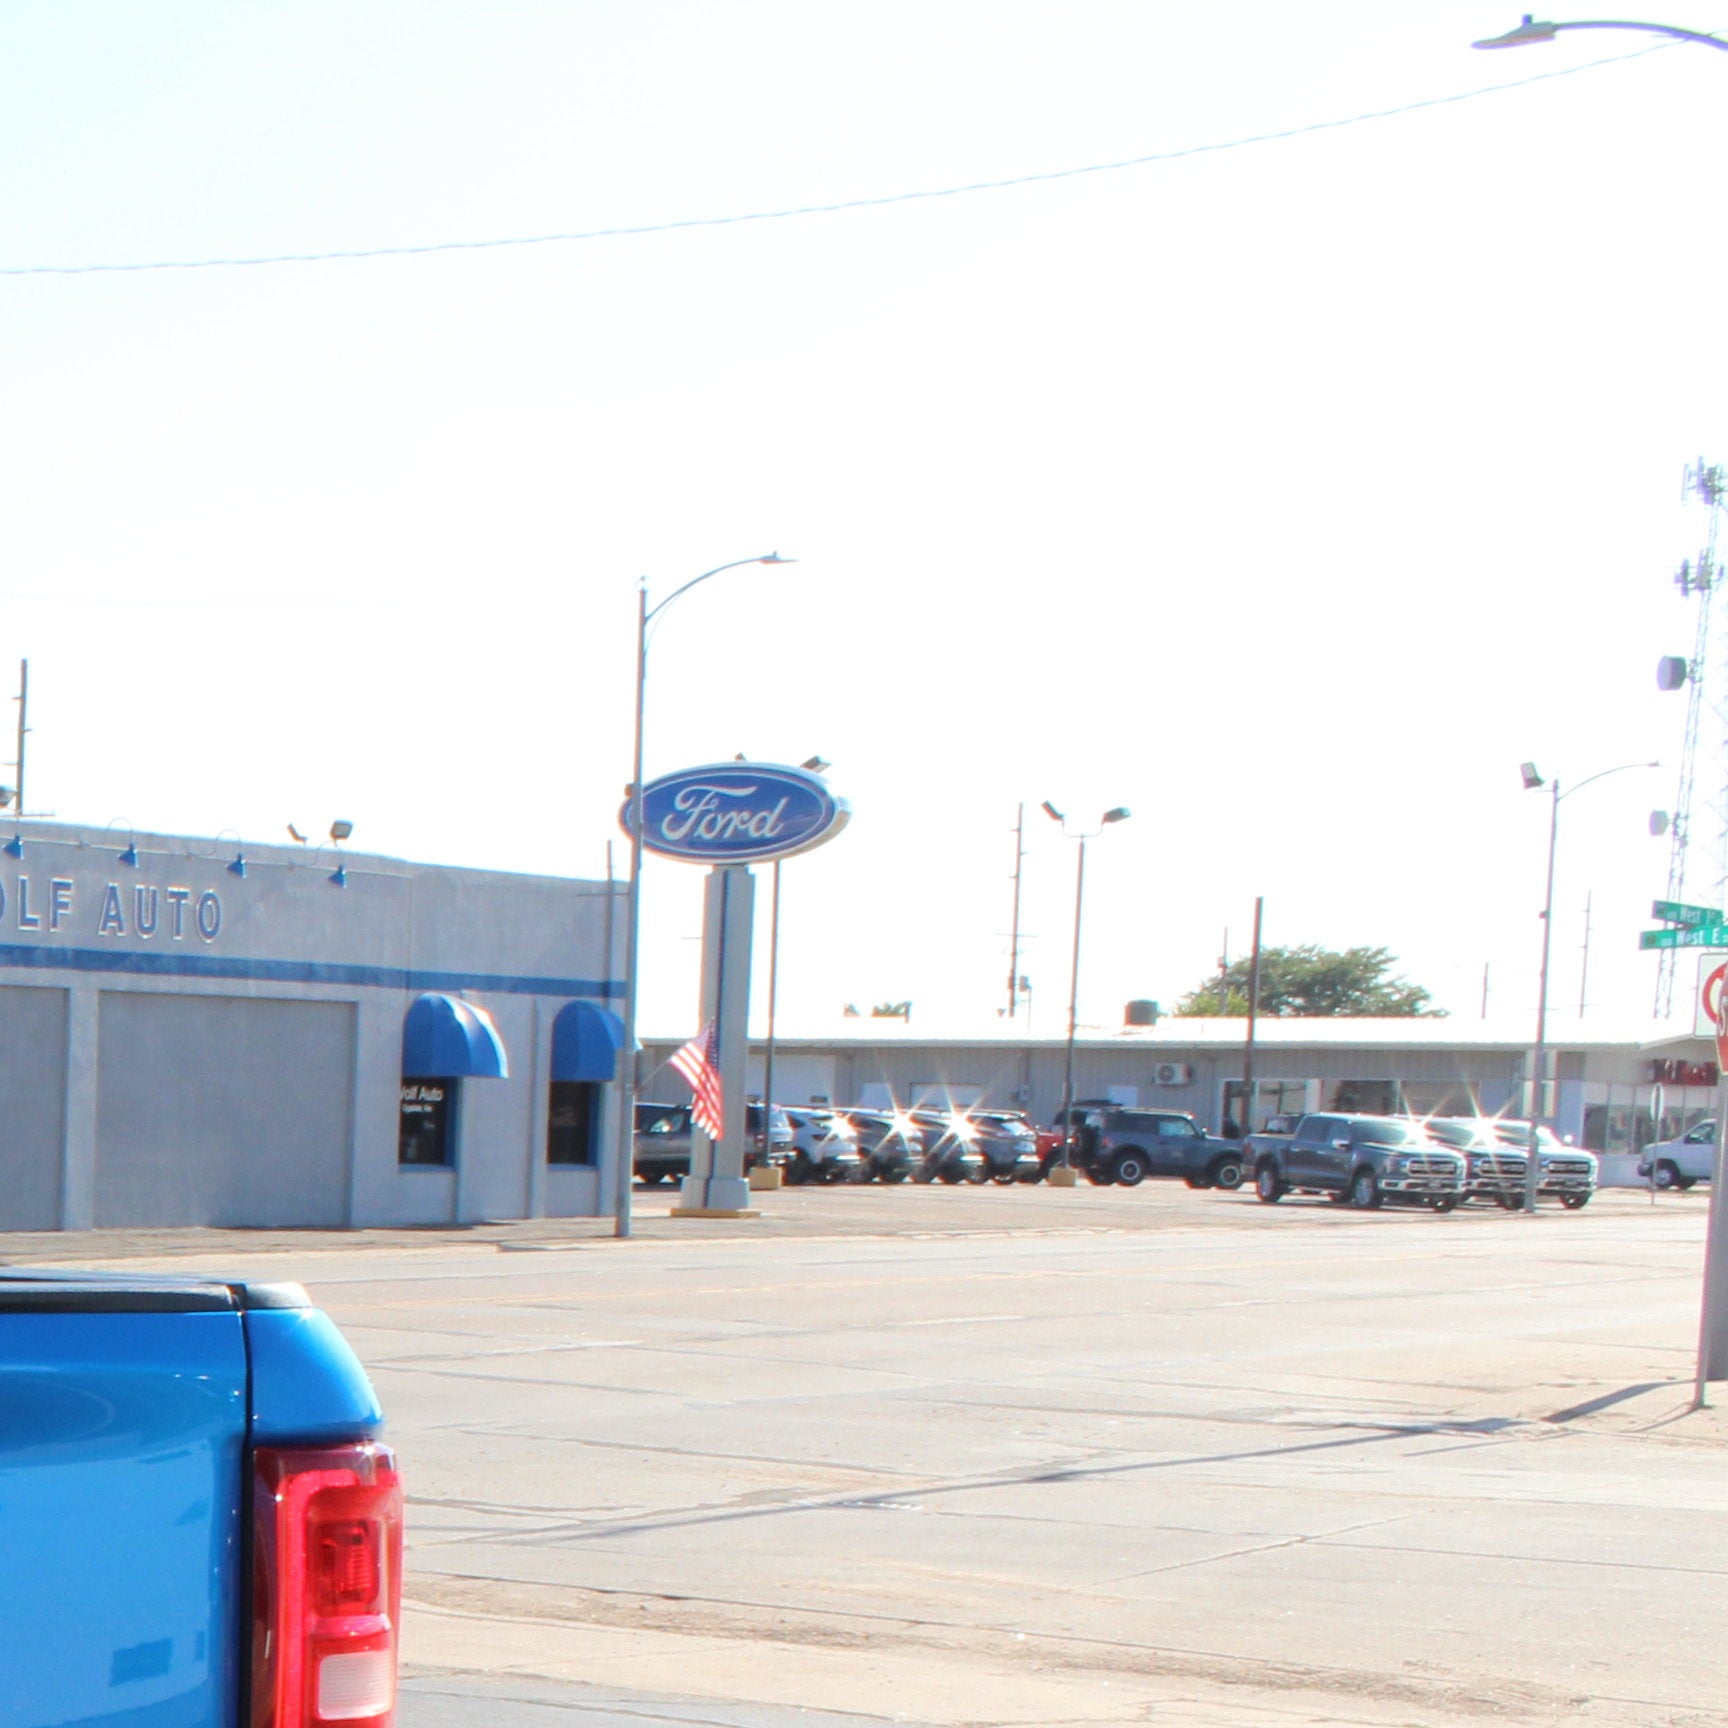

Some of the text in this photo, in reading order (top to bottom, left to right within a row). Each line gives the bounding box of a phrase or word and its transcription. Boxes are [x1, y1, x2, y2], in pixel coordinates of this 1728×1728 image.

[661, 785, 789, 841] Ford
[97, 882, 223, 943] AUTO
[1676, 928, 1705, 946] West
[1711, 926, 1721, 944] E
